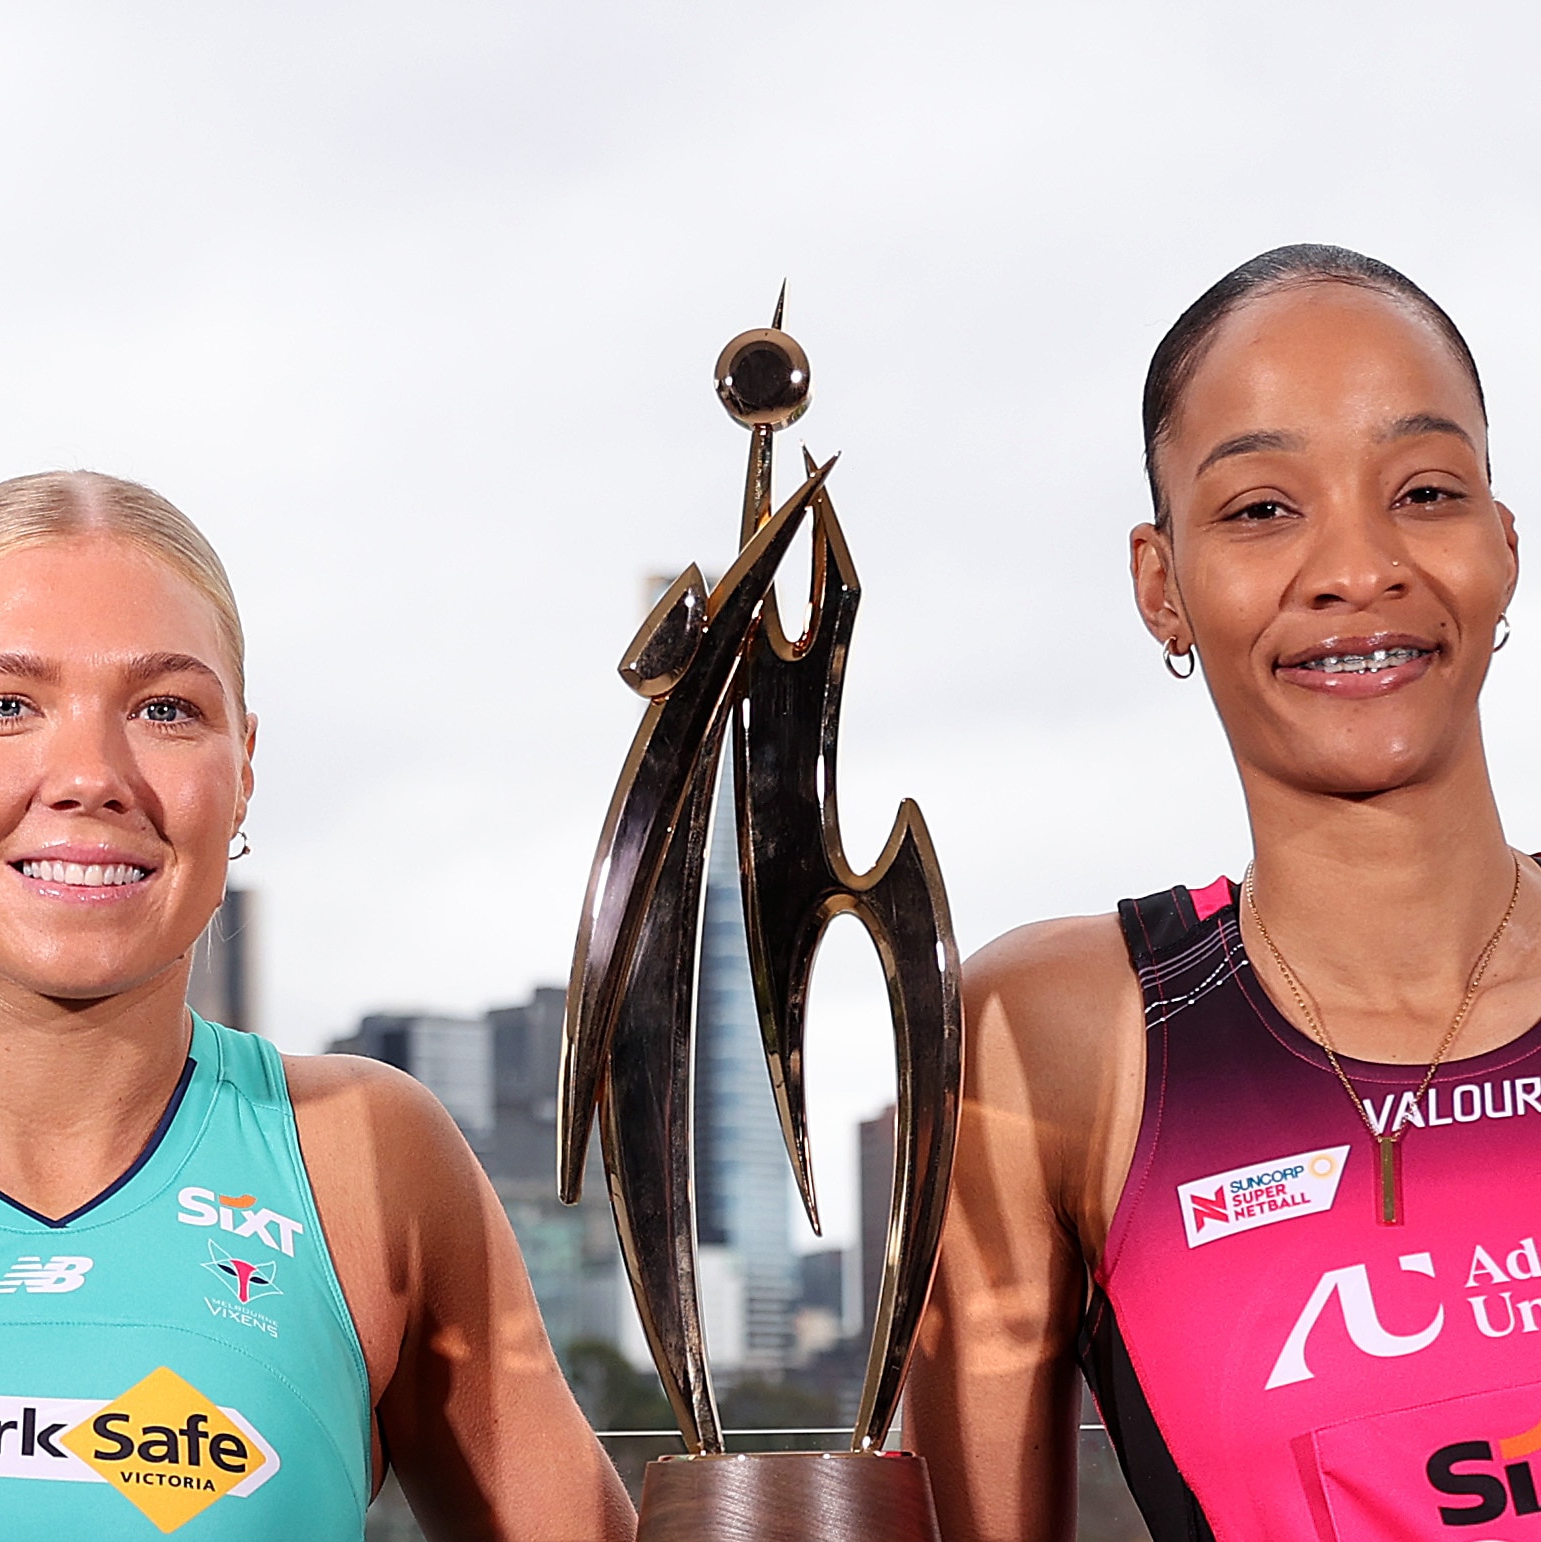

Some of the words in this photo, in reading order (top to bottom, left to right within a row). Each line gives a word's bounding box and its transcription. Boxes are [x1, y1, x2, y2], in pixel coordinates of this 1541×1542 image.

[1230, 1165, 1305, 1193] SUNCORP
[1232, 1184, 1288, 1207] SUPER
[1234, 1192, 1311, 1221] NETBALL
[204, 1297, 279, 1338] VIXENS
[212, 1299, 279, 1327] MELBOURNE
[119, 1471, 216, 1492] VICTORIA
